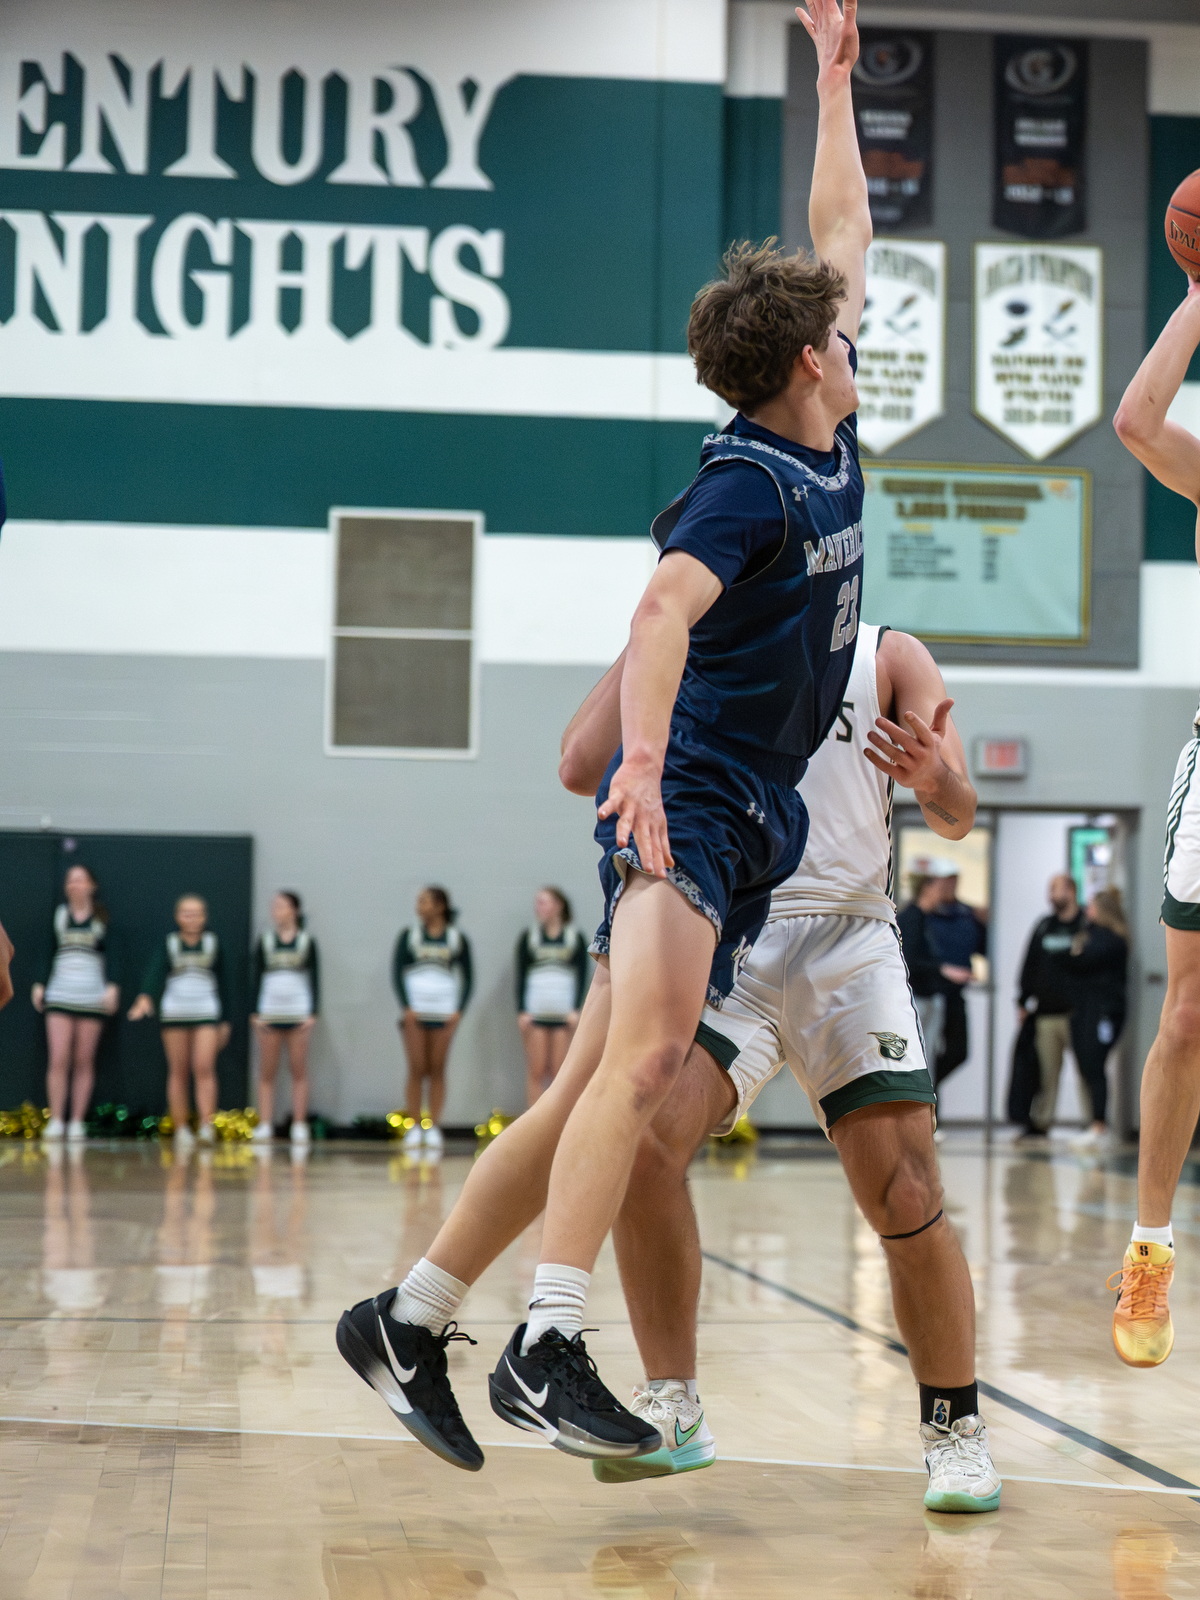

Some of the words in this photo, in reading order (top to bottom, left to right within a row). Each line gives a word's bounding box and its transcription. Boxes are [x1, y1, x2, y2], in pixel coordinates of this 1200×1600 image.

[0, 50, 506, 191] ENTURY
[0, 210, 511, 350] NIGHTS
[829, 574, 860, 653] 23
